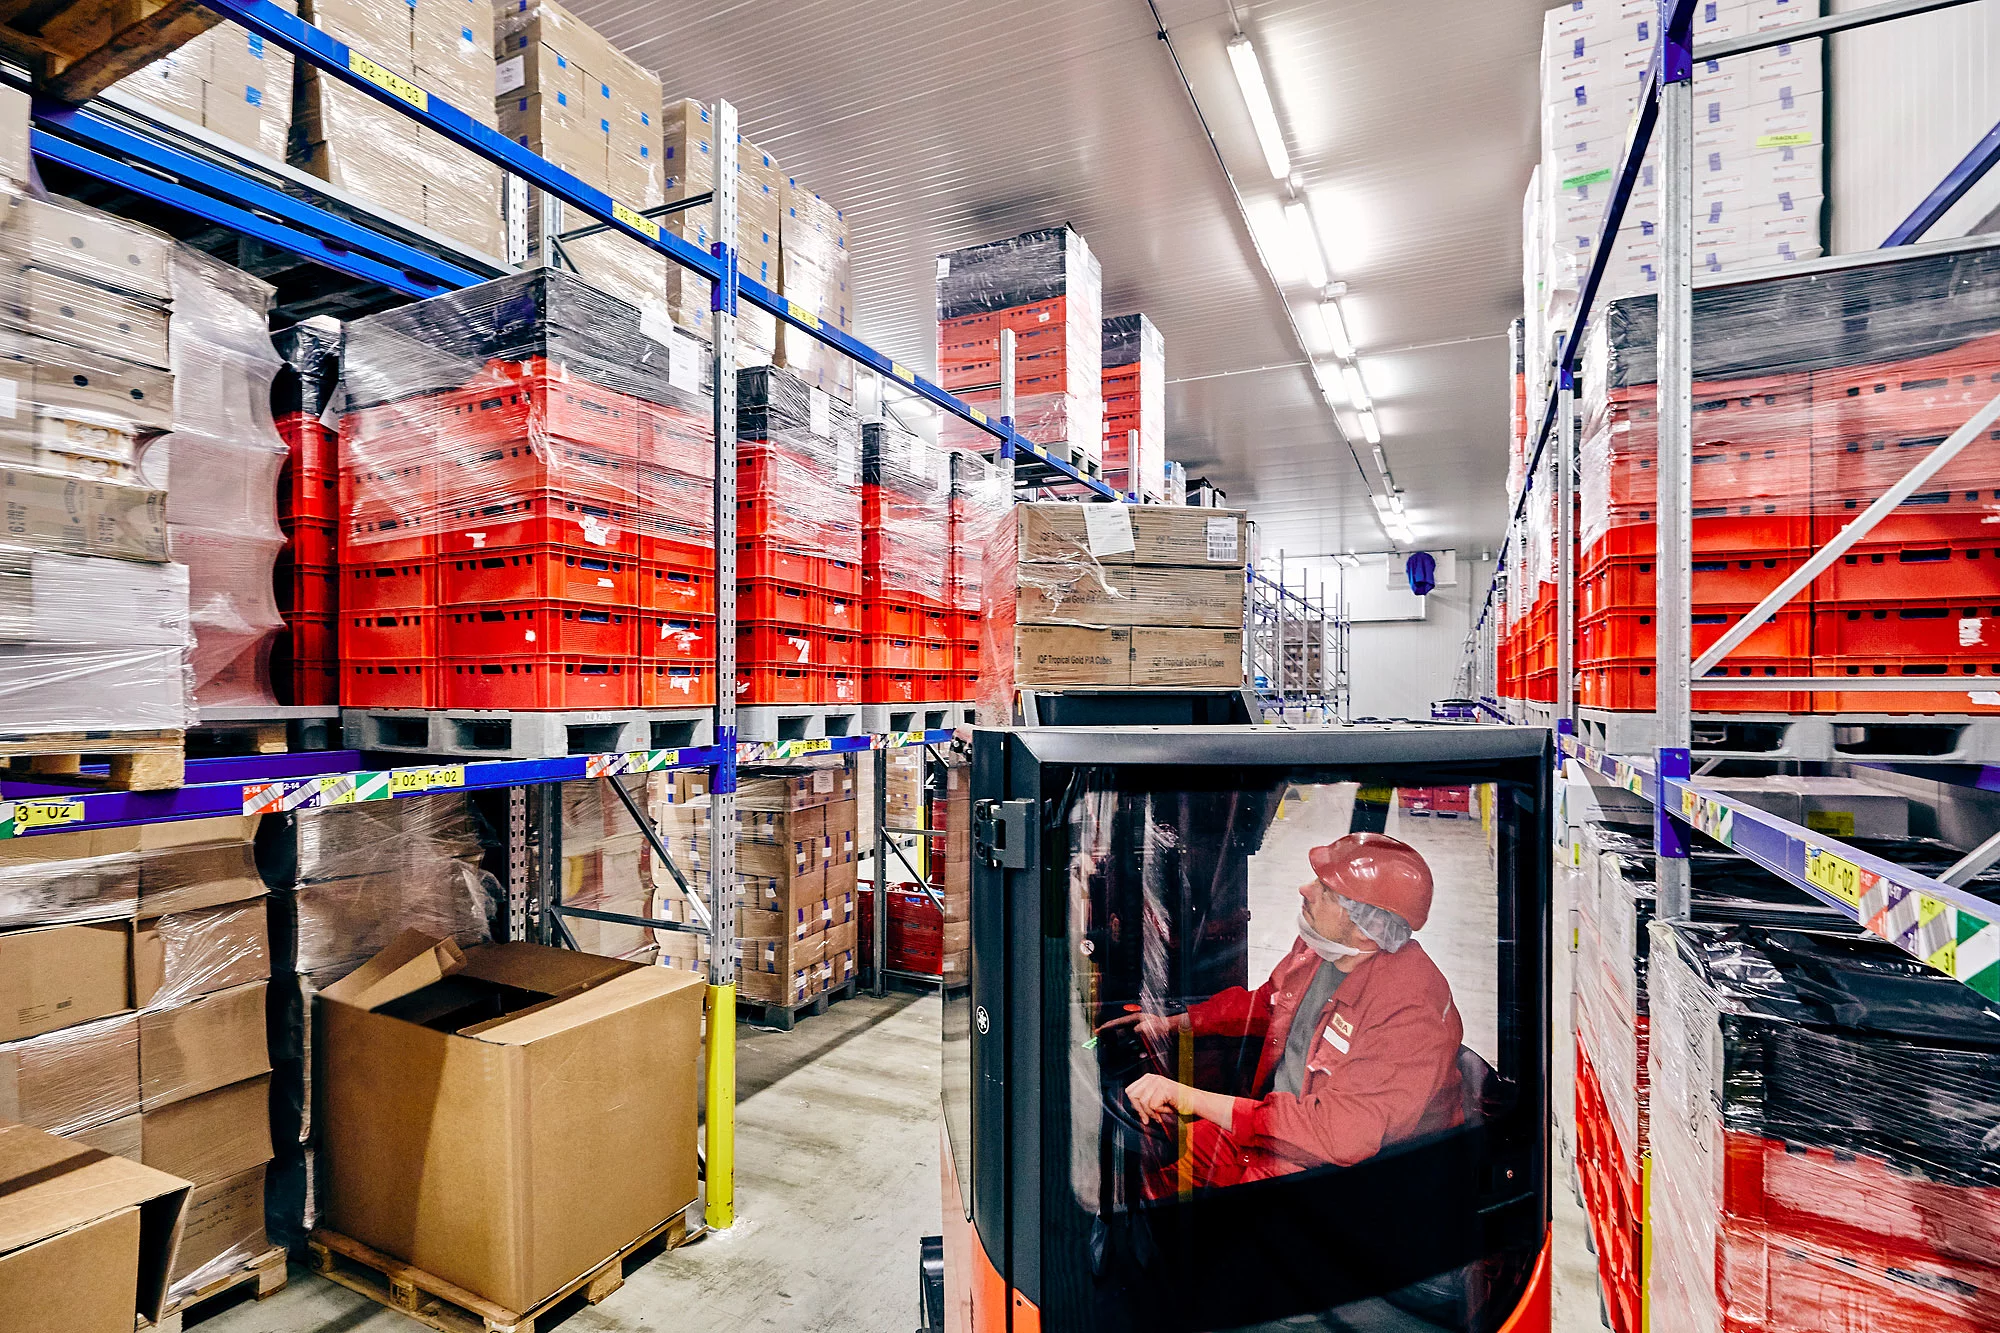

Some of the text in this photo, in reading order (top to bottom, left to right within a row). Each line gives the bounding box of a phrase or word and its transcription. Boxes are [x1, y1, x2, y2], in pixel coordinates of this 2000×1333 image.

[1049, 655, 1070, 666] Tropical
[1071, 656, 1084, 664] Gold
[1095, 656, 1112, 665] Cubes
[1185, 658, 1197, 667] Gold
[283, 782, 300, 790] 2-14
[308, 798, 316, 807] 2
